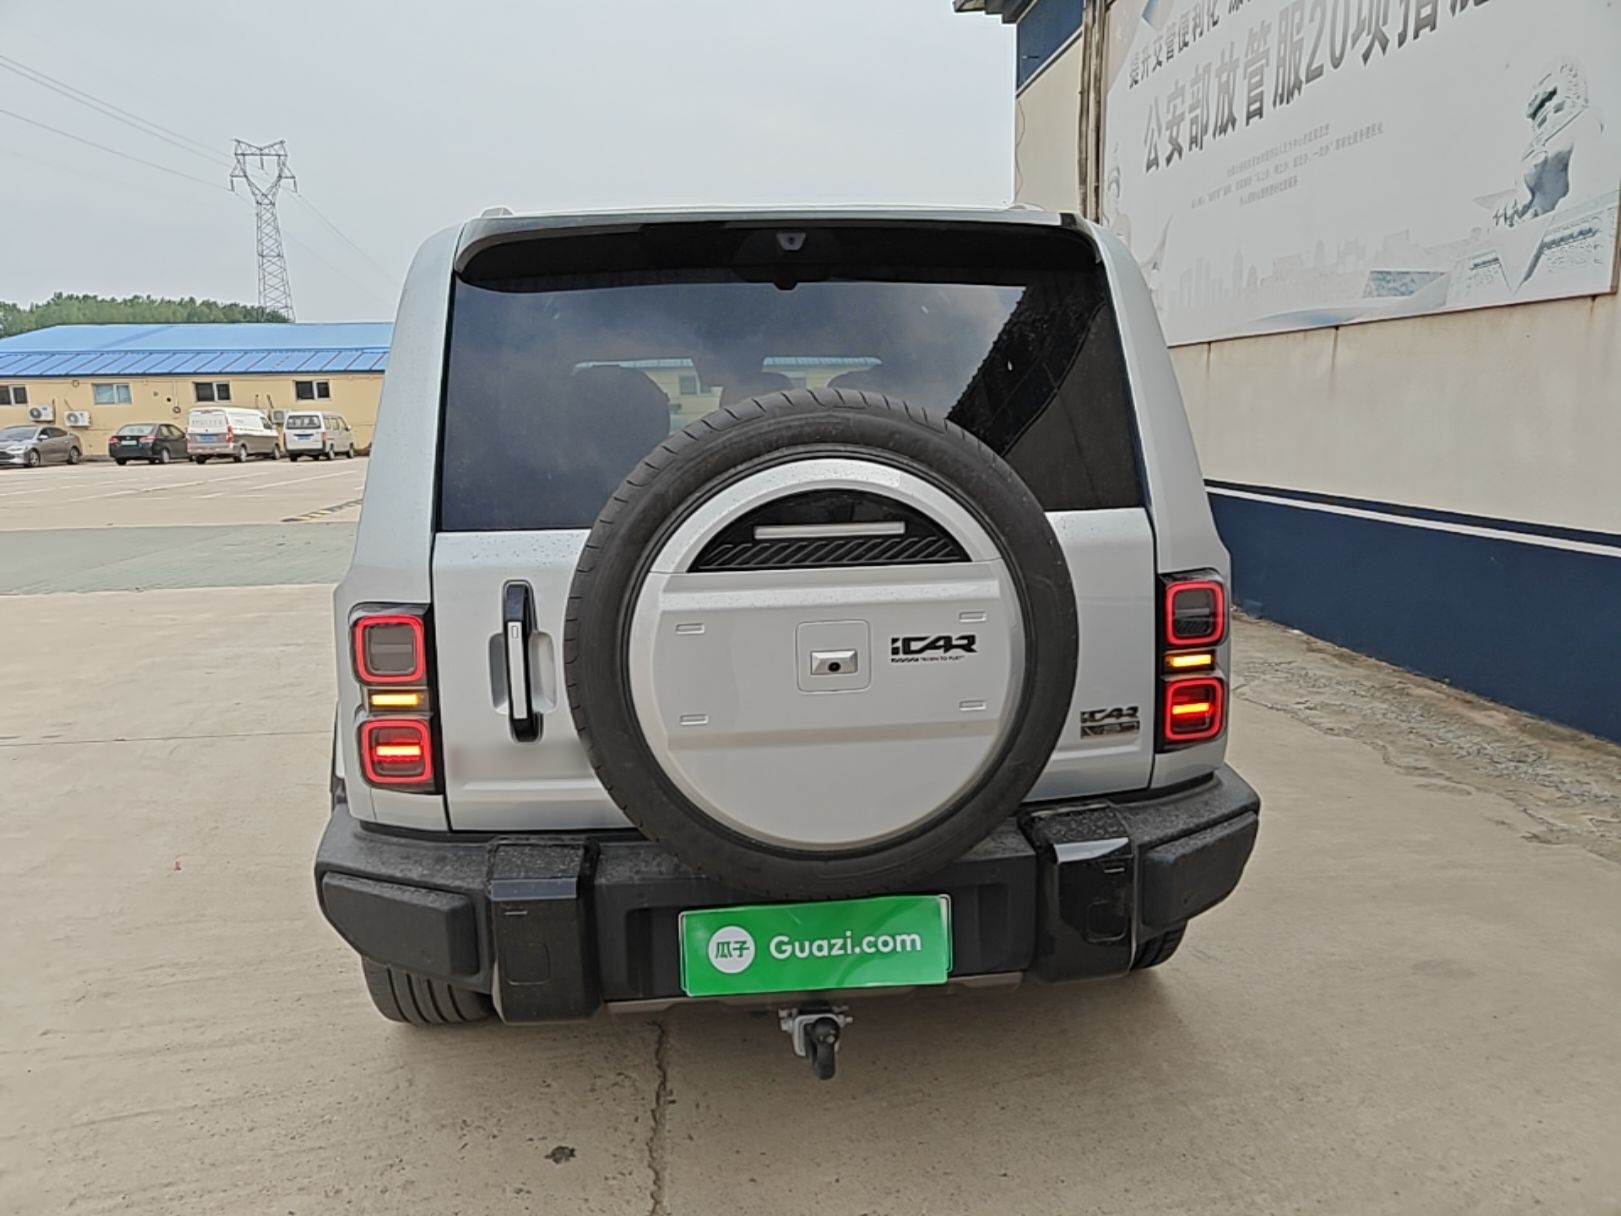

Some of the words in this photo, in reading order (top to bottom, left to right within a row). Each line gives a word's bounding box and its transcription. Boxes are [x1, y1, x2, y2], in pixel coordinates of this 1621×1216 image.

[1143, 0, 1490, 173] 公安部放管服20项
